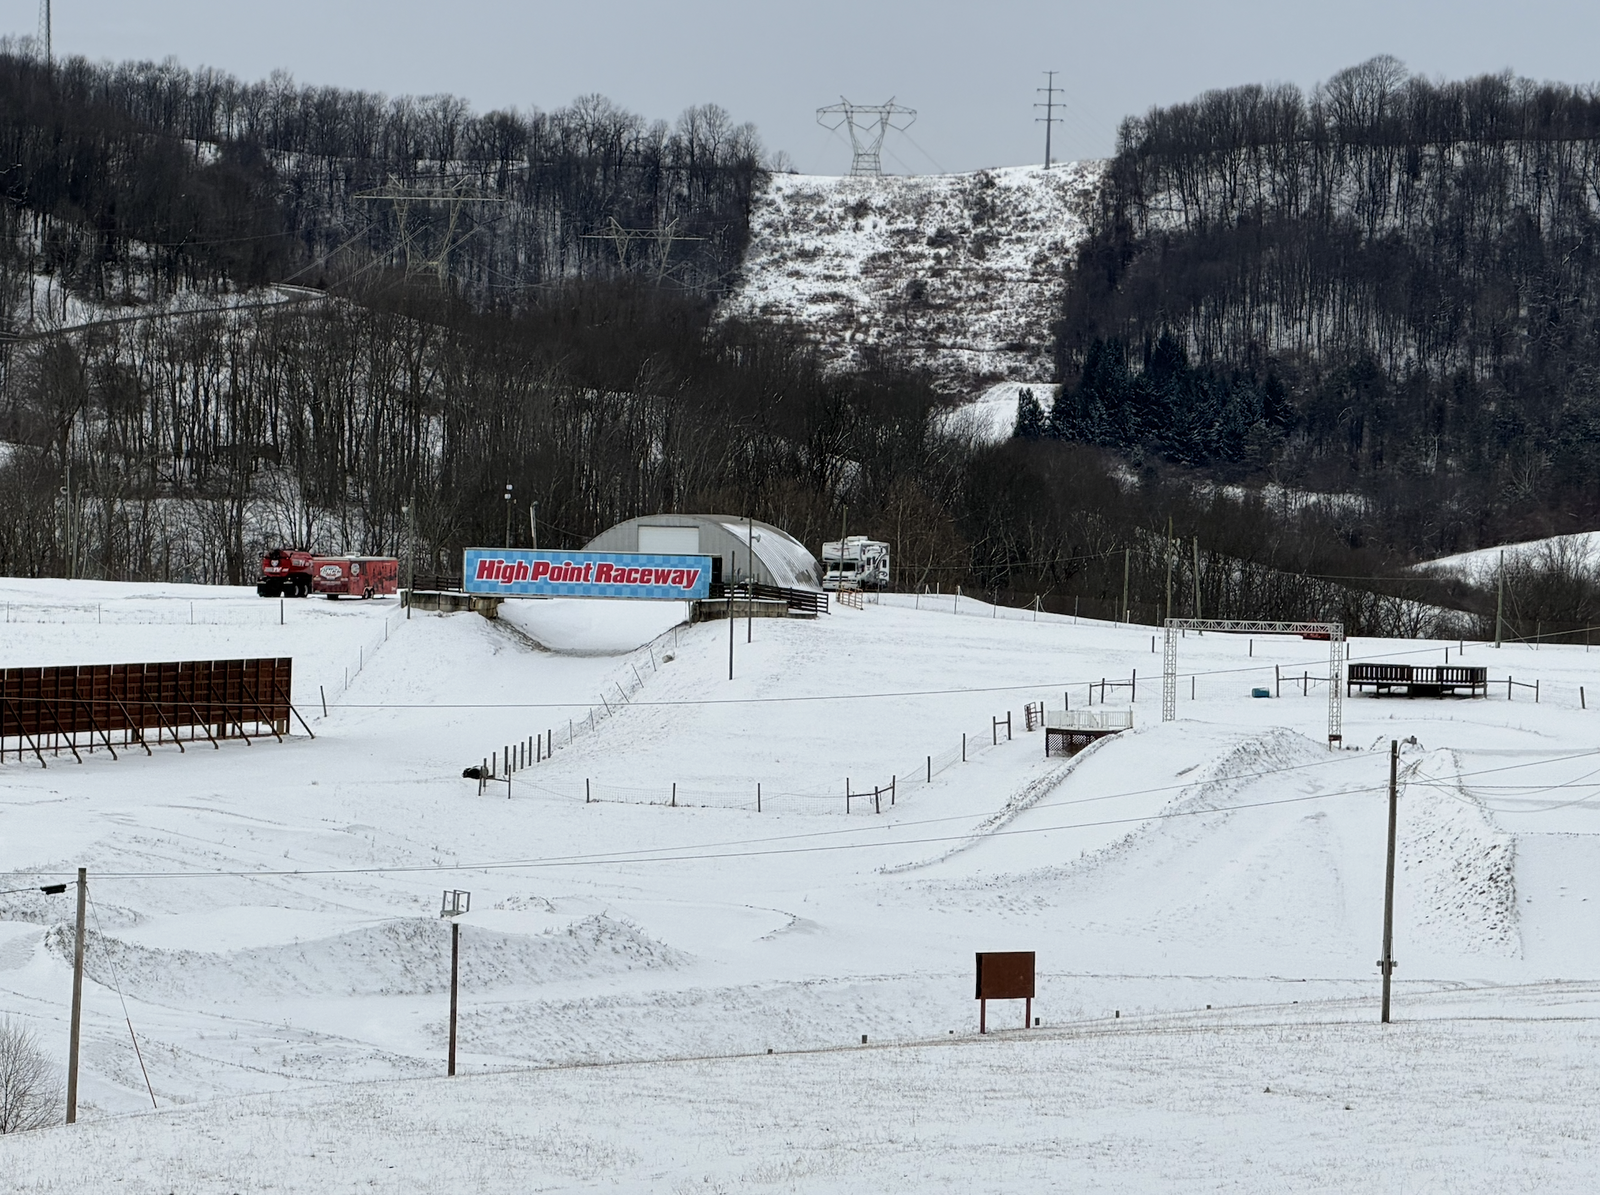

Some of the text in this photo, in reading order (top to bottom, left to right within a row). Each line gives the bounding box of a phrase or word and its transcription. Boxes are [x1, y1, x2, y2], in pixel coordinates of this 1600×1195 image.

[476, 559, 700, 589] High Point Raceway
